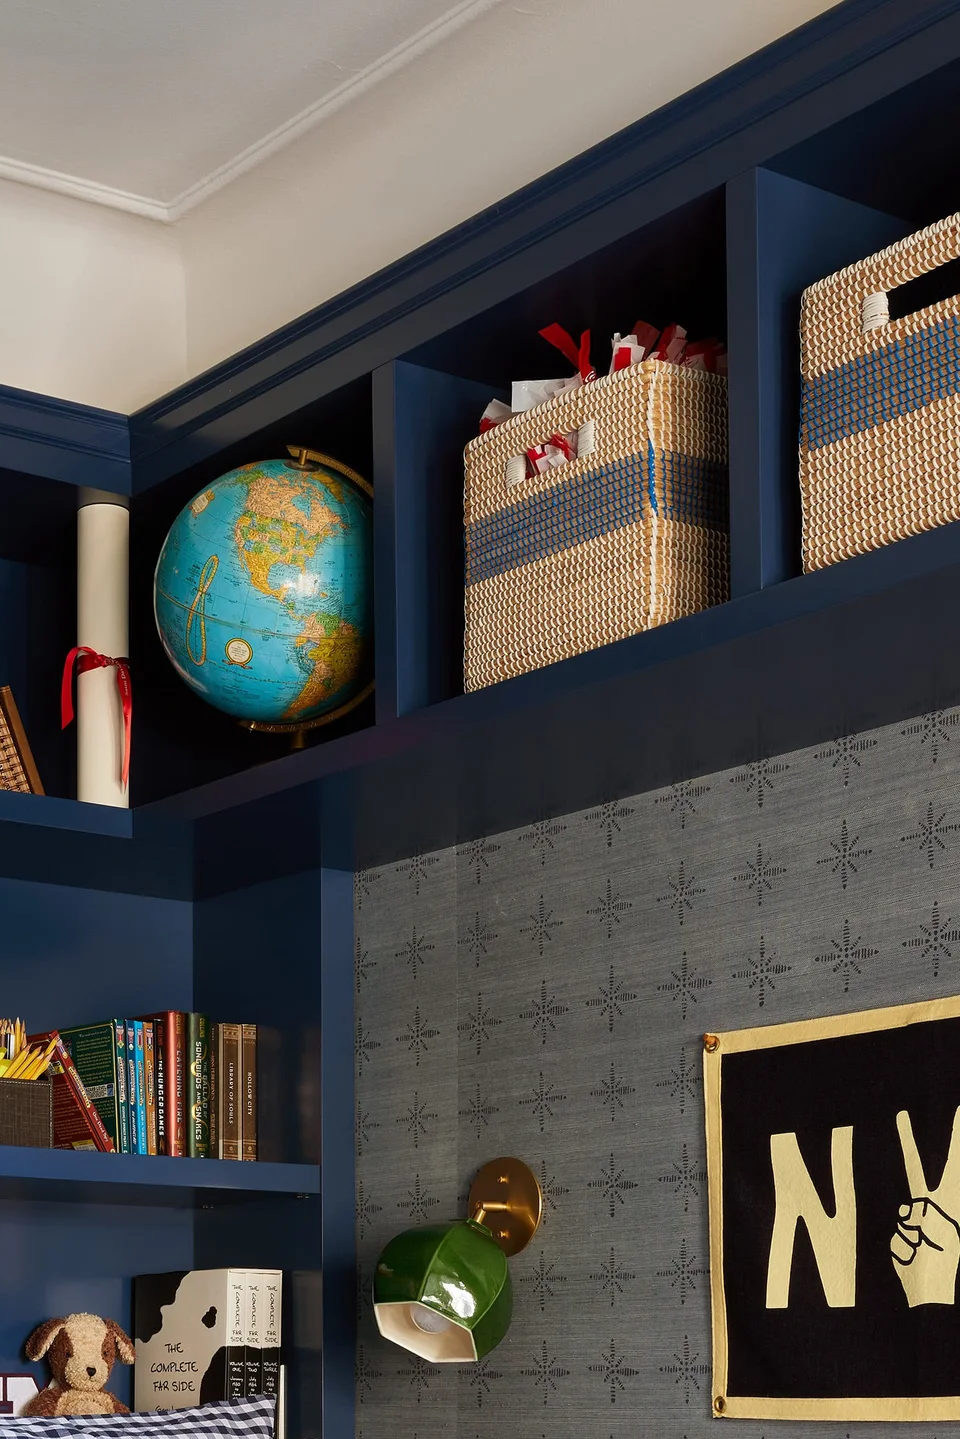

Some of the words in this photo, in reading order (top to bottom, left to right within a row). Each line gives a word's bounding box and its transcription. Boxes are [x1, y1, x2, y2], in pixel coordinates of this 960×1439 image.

[229, 1092, 234, 1101] OF
[165, 1343, 184, 1353] THE
[151, 1362, 198, 1373] COMPLETE
[153, 1381, 169, 1392] FAR
[172, 1381, 195, 1392] SIDE
